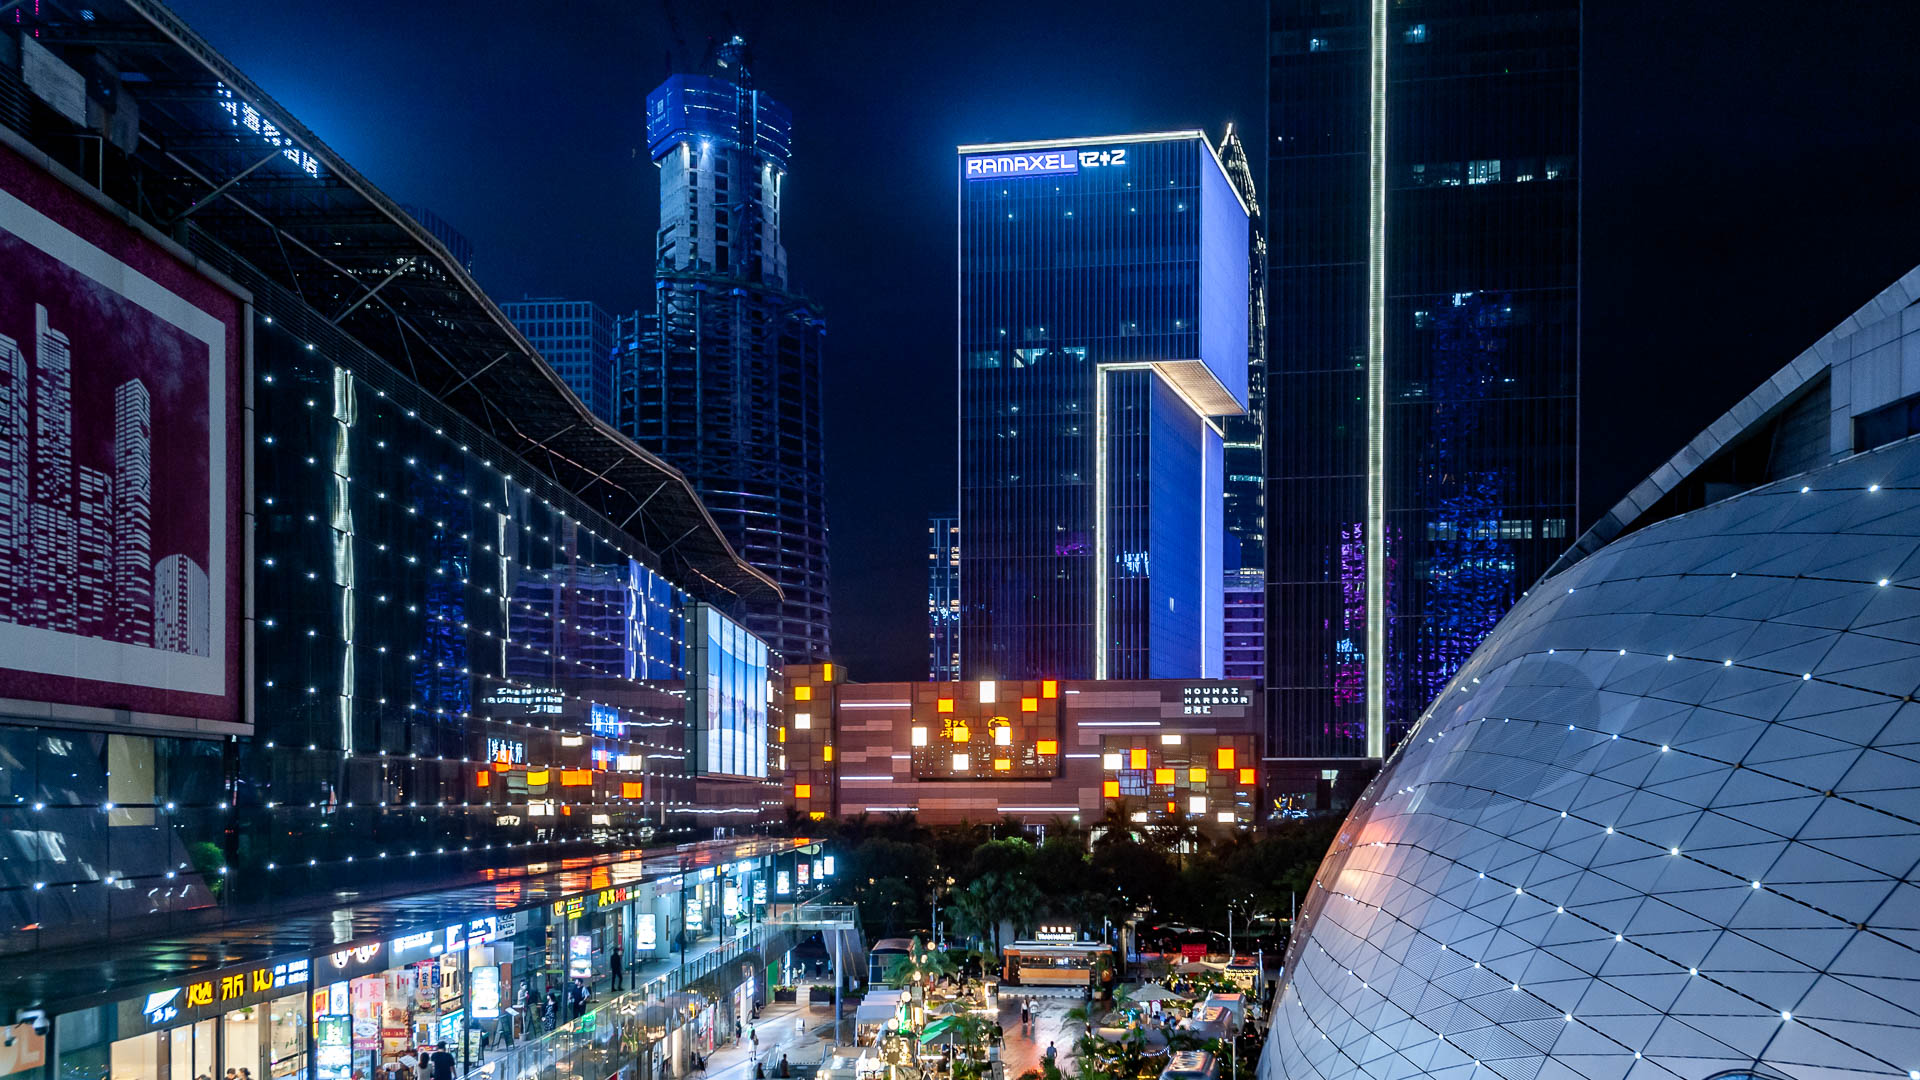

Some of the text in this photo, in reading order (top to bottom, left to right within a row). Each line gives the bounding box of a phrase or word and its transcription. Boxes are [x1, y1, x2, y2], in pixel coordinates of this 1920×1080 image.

[967, 154, 1075, 175] RAMAXEL
[1184, 687, 1239, 695] HOUHAI
[1184, 696, 1248, 704] HARBOUR
